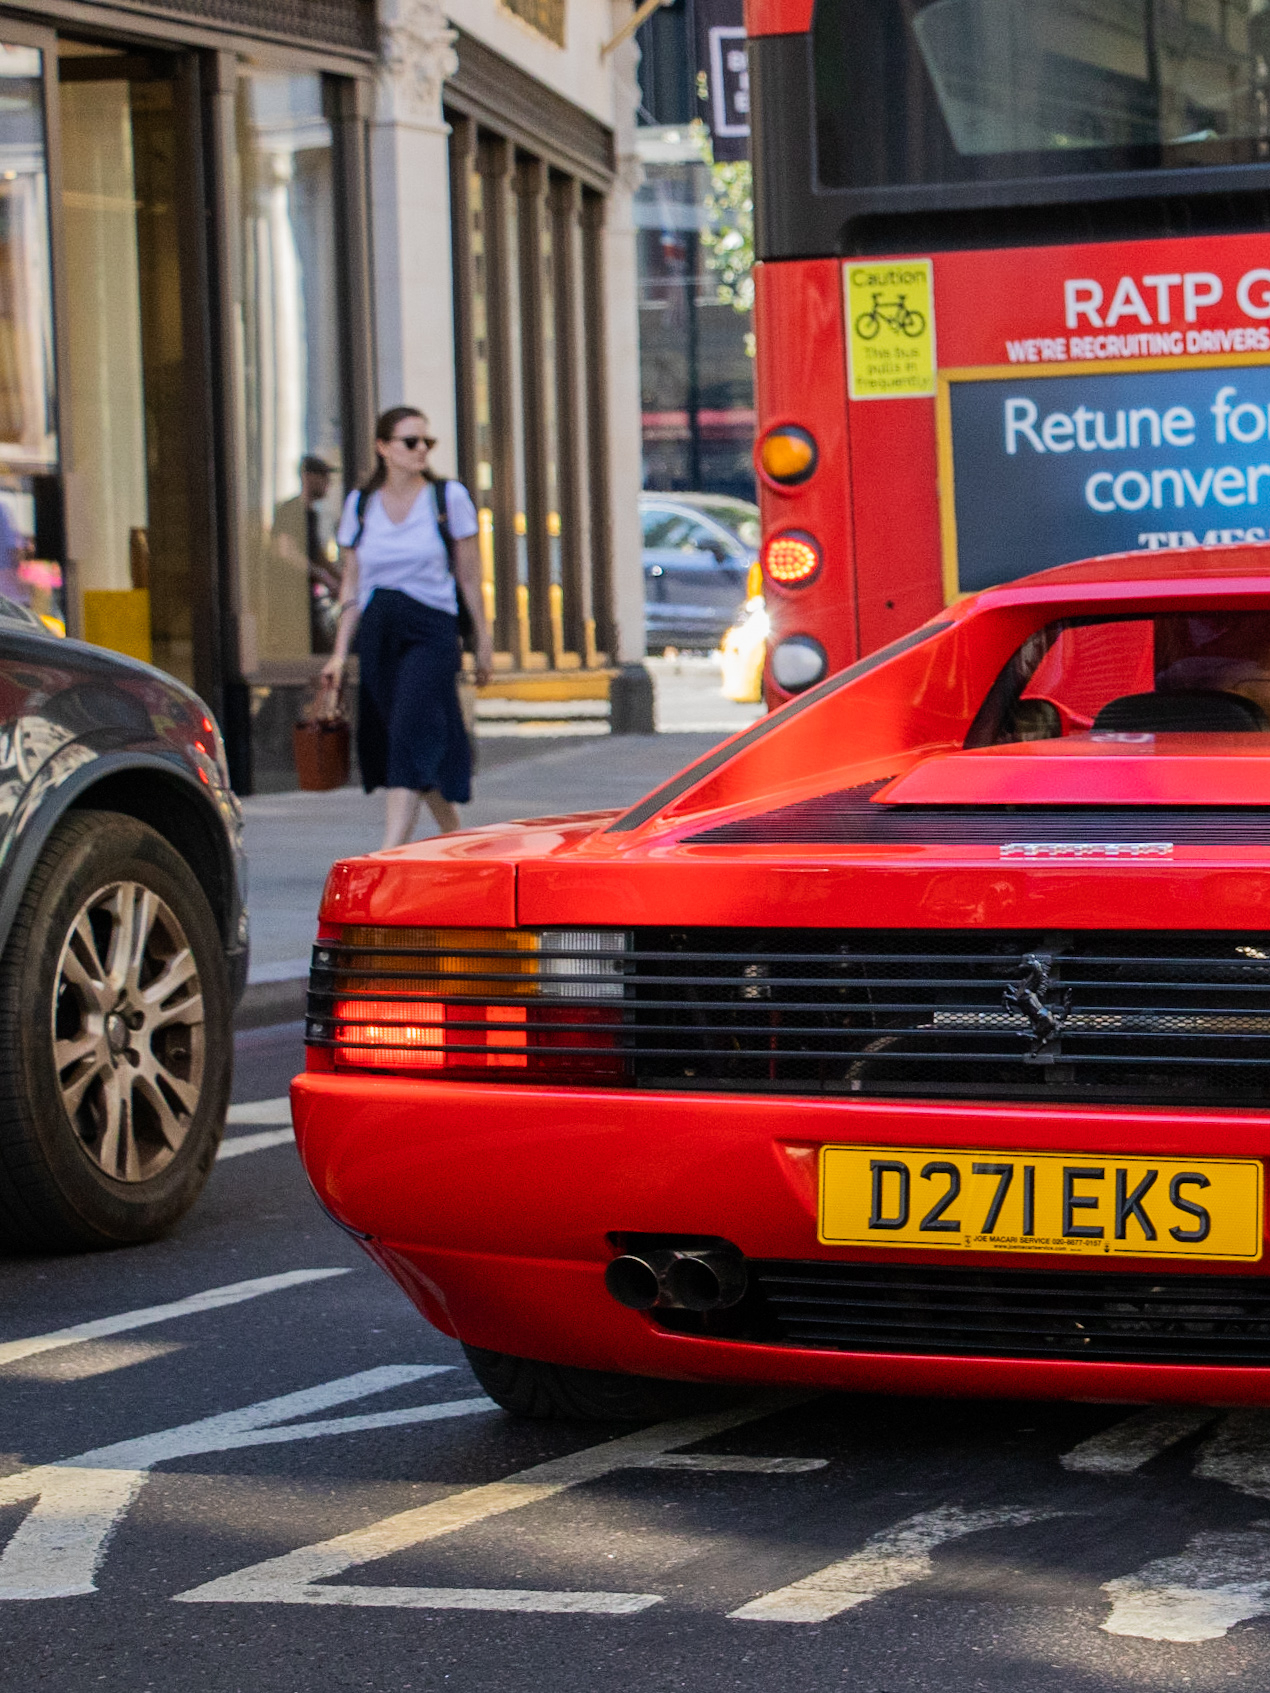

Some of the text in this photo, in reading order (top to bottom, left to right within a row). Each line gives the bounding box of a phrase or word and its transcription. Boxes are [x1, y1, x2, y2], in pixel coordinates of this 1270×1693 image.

[851, 268, 927, 288] Caution
[1063, 272, 1223, 330] RATP
[865, 345, 919, 359] This bus
[1005, 337, 1068, 363] WE'RE
[1069, 330, 1184, 359] RECRUITING
[1185, 326, 1270, 354] DRIVERS
[1004, 397, 1196, 455] Retune
[868, 1159, 1213, 1244] D271 EKS
[1019, 1236, 1051, 1245] SERVICE
